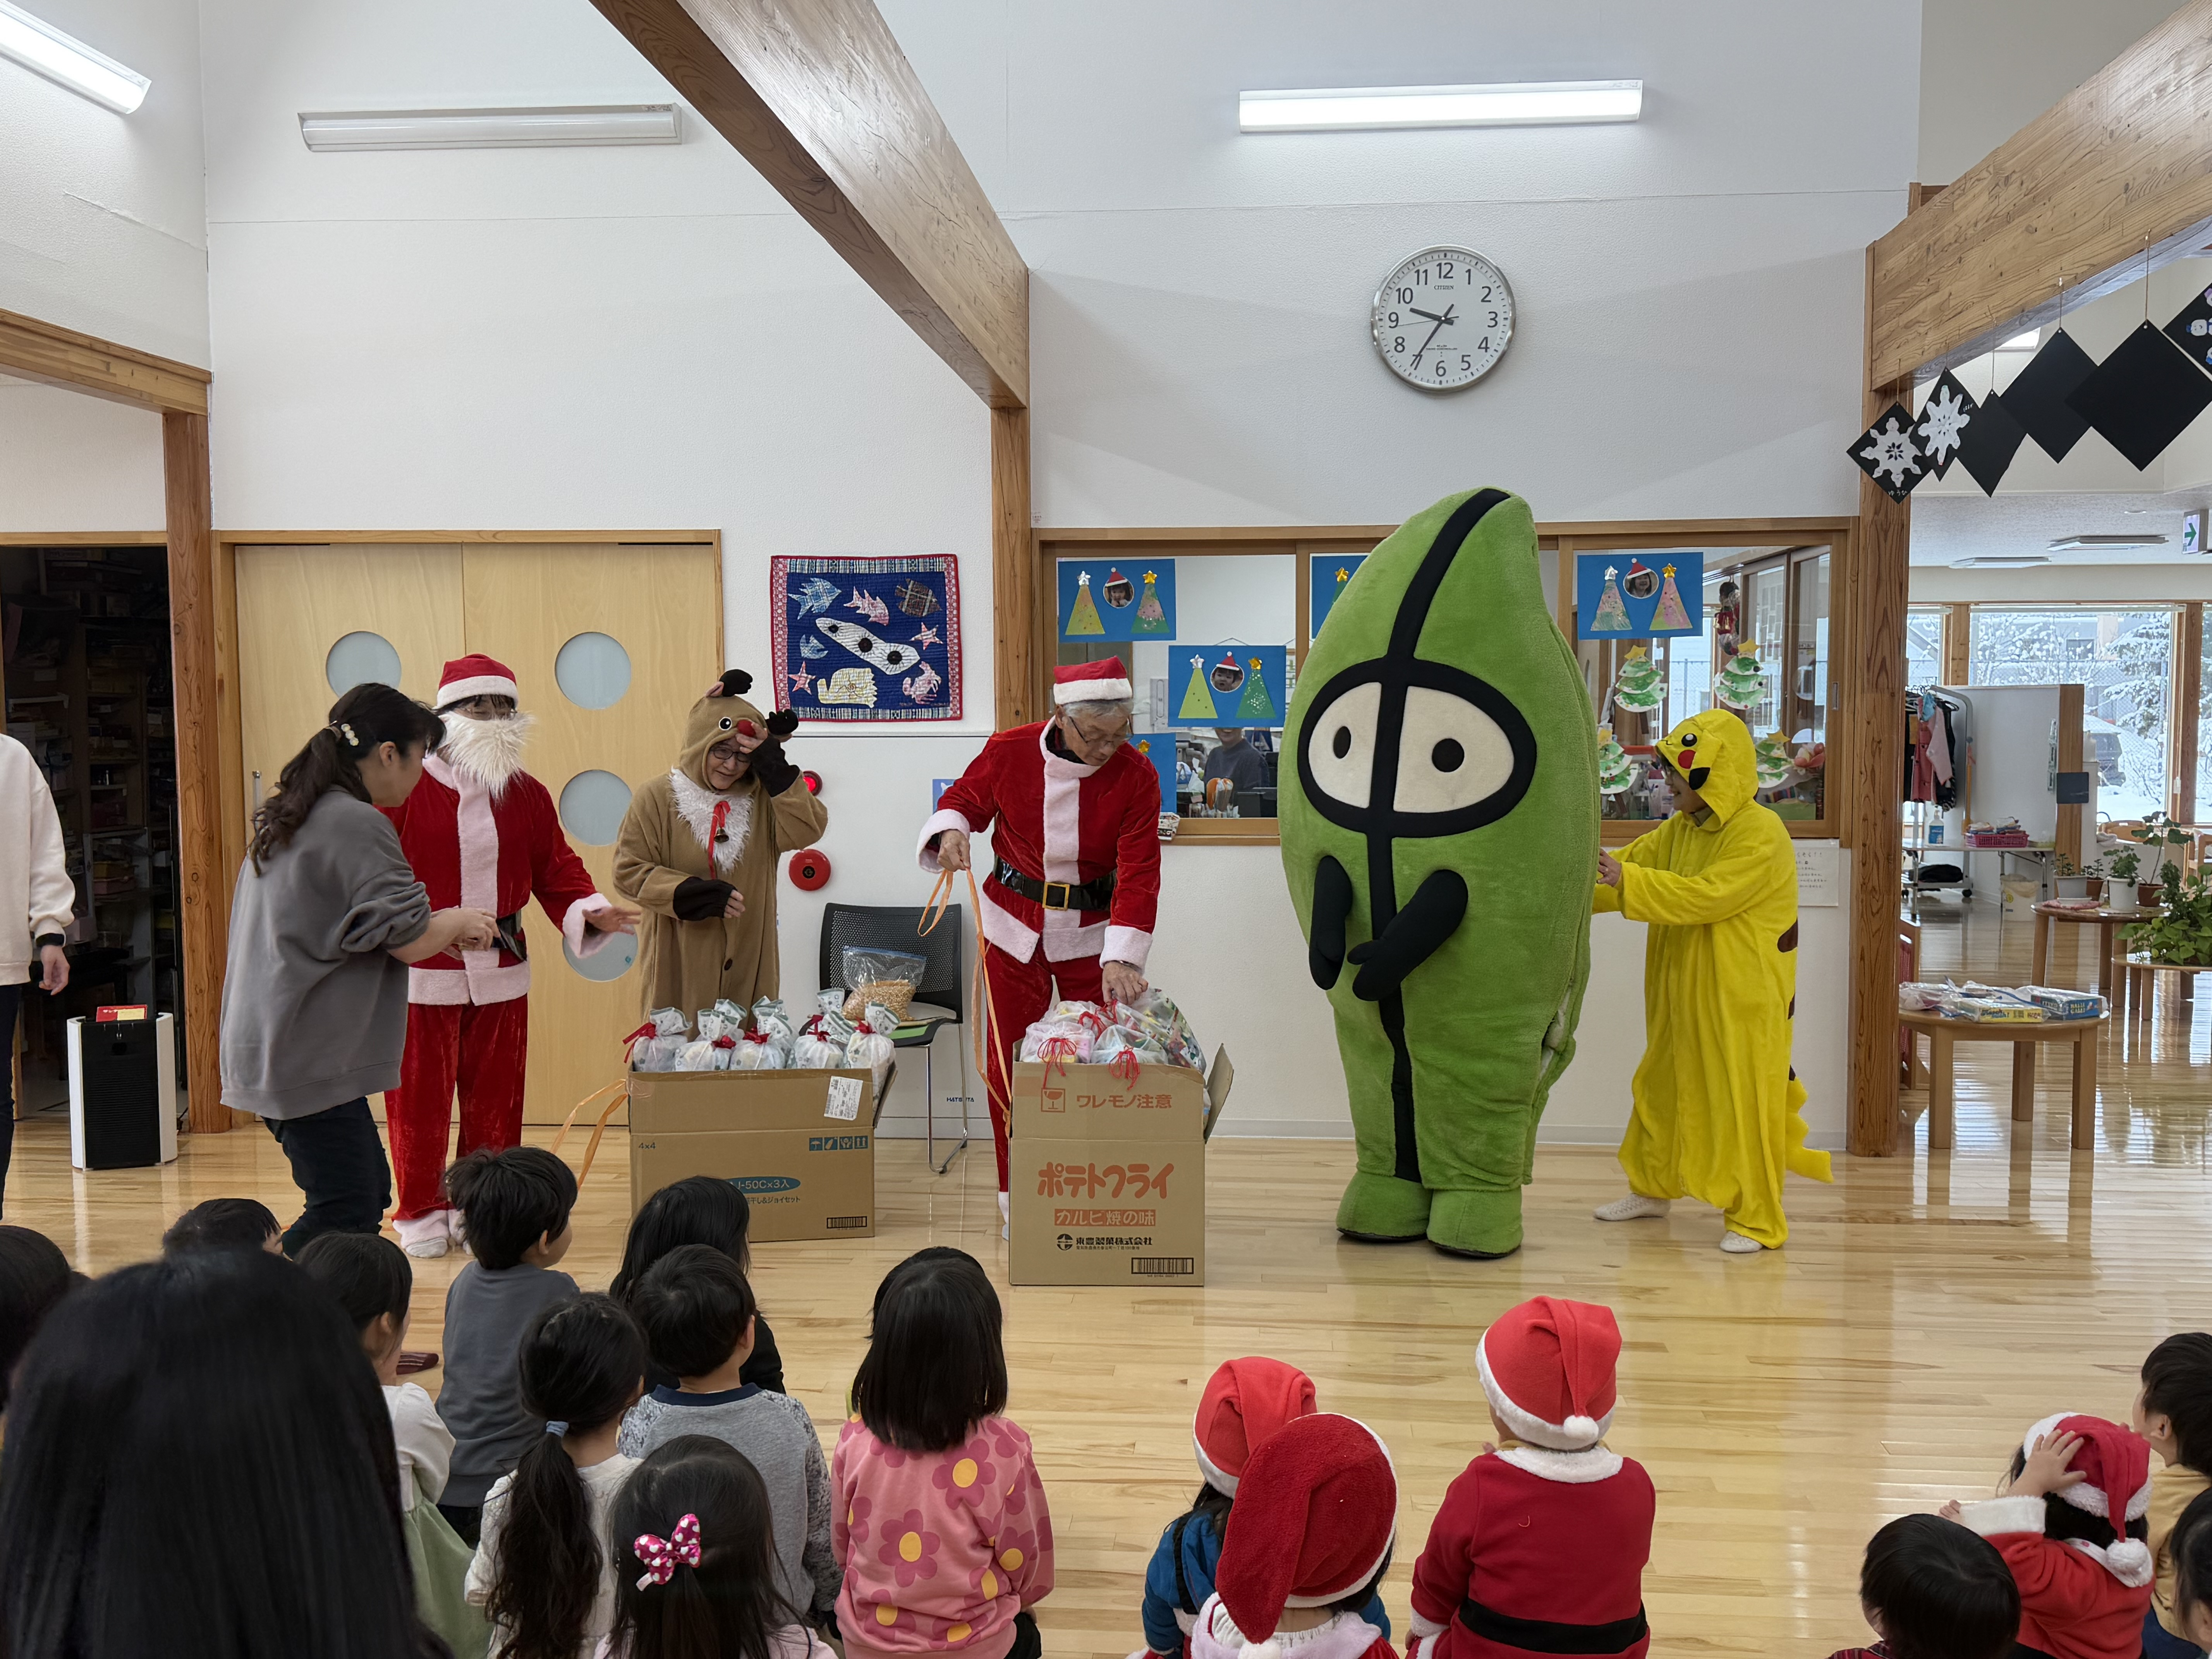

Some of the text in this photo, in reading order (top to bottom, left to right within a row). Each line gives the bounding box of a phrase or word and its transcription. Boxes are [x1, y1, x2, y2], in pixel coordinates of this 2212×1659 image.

[1414, 269, 1428, 285] 11
[1436, 262, 1454, 279] 12
[1465, 269, 1471, 285] 1
[1395, 287, 1413, 304] 10
[1481, 286, 1492, 302] 2
[1388, 312, 1399, 328] 9
[1487, 311, 1498, 328] 3
[1394, 336, 1405, 353] 8
[1477, 337, 1490, 352] 4
[1412, 354, 1423, 370] 7
[1436, 360, 1446, 377] 6
[1461, 354, 1471, 371] 5
[1076, 1094, 1173, 1109] ワレモノ注意
[1037, 1162, 1174, 1199] ポテトフライ
[1056, 1210, 1155, 1225] カルビ焼の味
